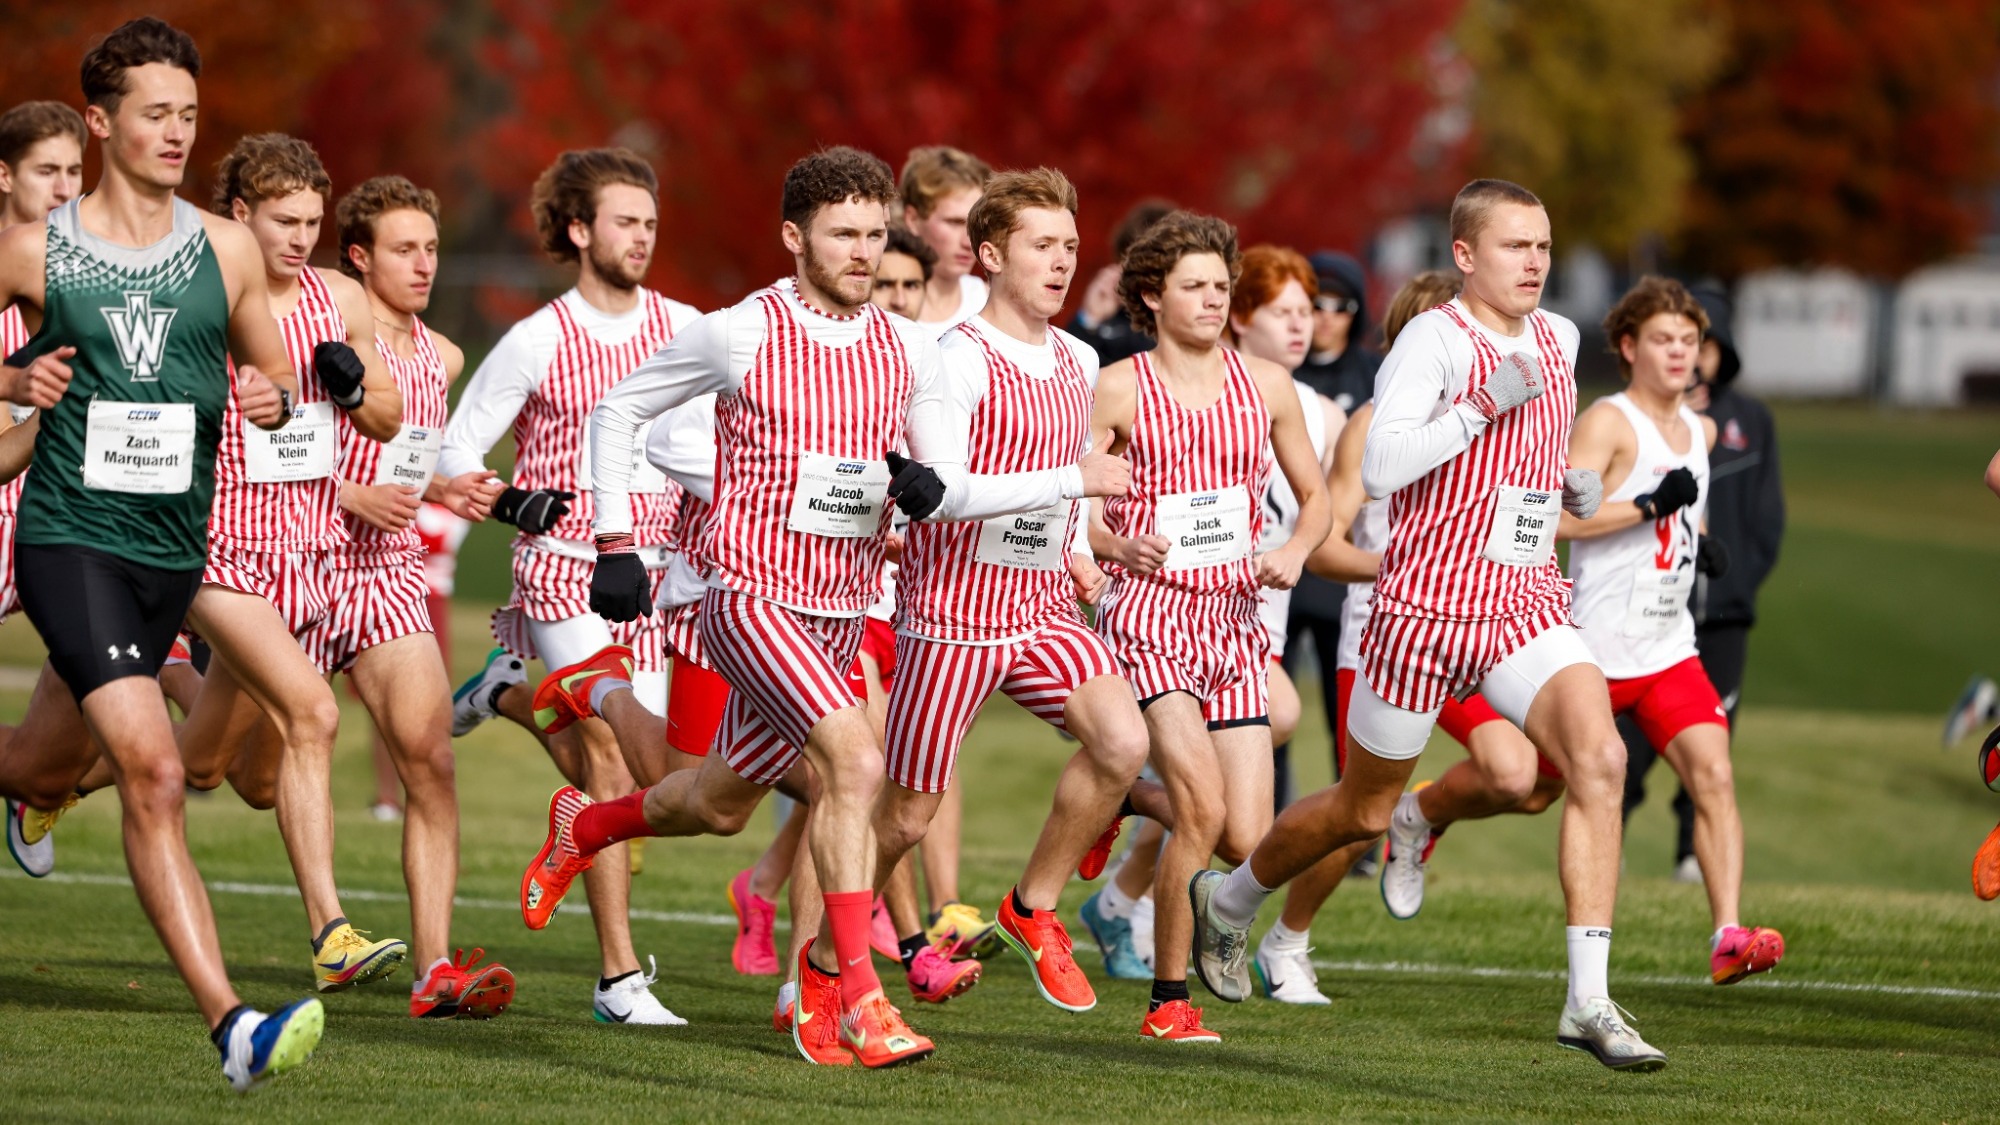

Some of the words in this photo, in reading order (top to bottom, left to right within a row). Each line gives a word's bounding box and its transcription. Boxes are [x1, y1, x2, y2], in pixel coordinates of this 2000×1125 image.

[127, 410, 161, 421] CCIW
[126, 435, 161, 449] Zach
[270, 430, 315, 445] Richard
[104, 450, 179, 469] Marquardt
[278, 447, 307, 459] Klein
[835, 463, 866, 475] CCIW
[827, 485, 864, 499] Jacob
[808, 497, 871, 515] Kluckhohn
[1190, 495, 1219, 507] CCIW
[1014, 517, 1046, 532] Oscar
[1193, 517, 1222, 531] Jack
[1516, 515, 1544, 529] Brian
[1002, 531, 1048, 549] Frontjes
[1180, 531, 1234, 547] Galminas
[1514, 530, 1539, 547] Sorg
